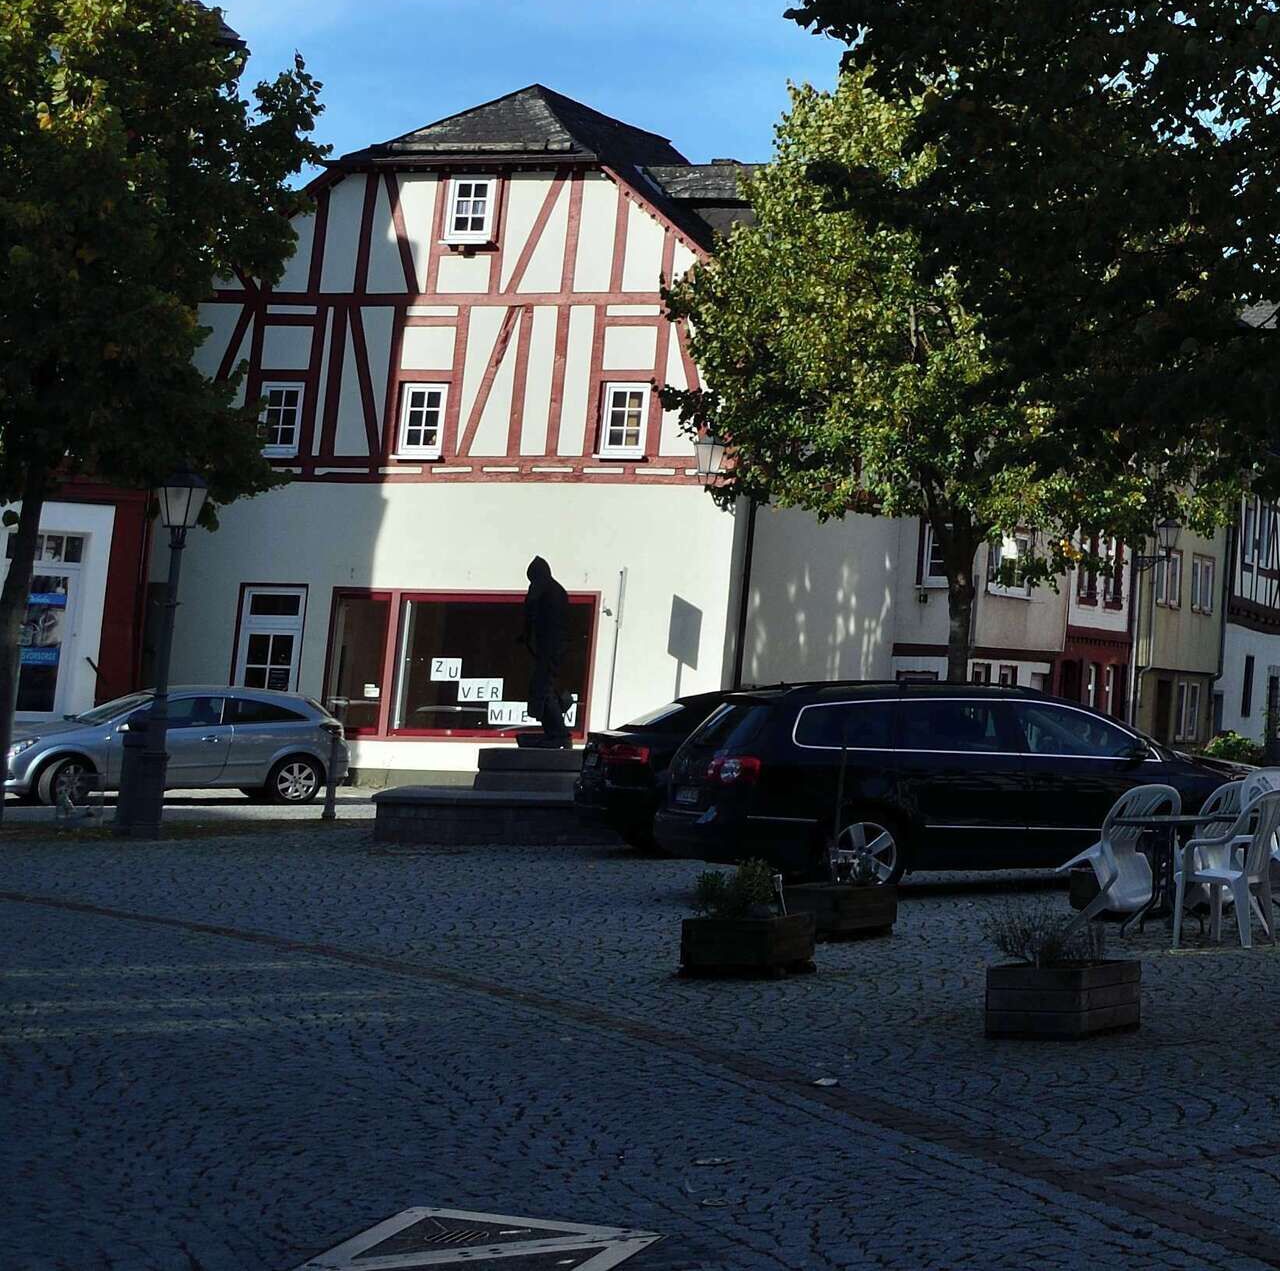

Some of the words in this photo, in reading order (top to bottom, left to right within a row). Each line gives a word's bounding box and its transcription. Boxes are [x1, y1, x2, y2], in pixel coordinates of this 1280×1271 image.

[435, 660, 458, 678] ZU
[462, 686, 499, 699] VER
[490, 709, 573, 723] MIEN
